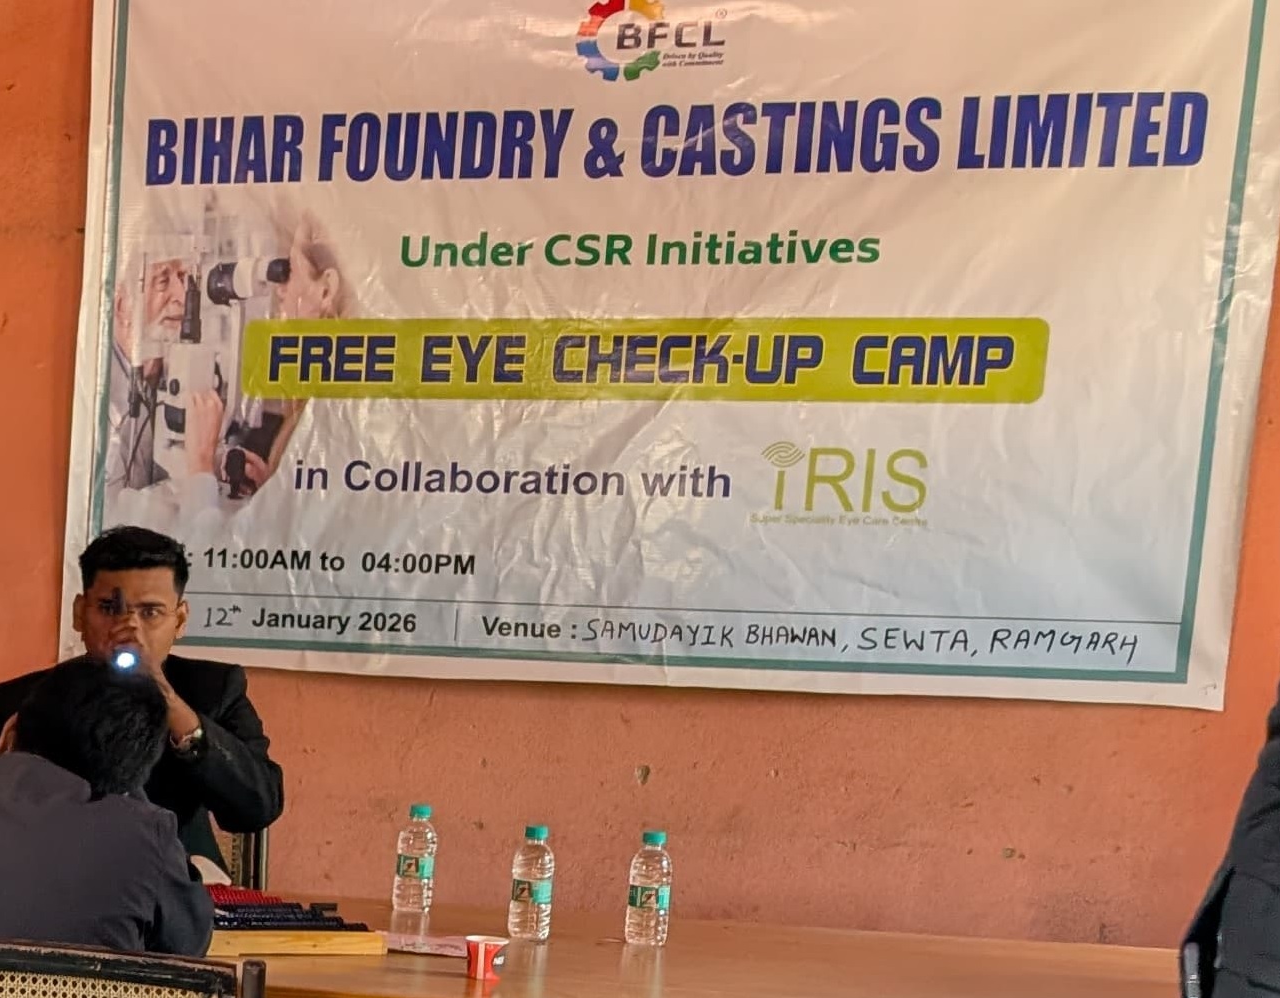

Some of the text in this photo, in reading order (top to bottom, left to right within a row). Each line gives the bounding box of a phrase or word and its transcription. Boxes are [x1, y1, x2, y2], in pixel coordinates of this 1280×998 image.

[616, 21, 726, 50] BFCL
[145, 91, 1210, 187] BIHAR FOUNDRY & CASTINGS LIMITED
[399, 229, 882, 268] Under CSR Initiatives
[268, 333, 1016, 387] FREE EYE CHECK-UP CAMP
[293, 458, 732, 500] in Collaboration with
[202, 547, 312, 571] 11:00AM
[320, 551, 346, 573] to
[360, 551, 477, 576] 04:00PM
[251, 607, 351, 636] January
[357, 611, 418, 634] 2026
[481, 615, 562, 640] Venue
[582, 618, 735, 648] SAMUDAYIK
[744, 622, 849, 655] BHAWAN,
[856, 626, 980, 658] SEWTA,
[989, 628, 1139, 666] RAMGARH
